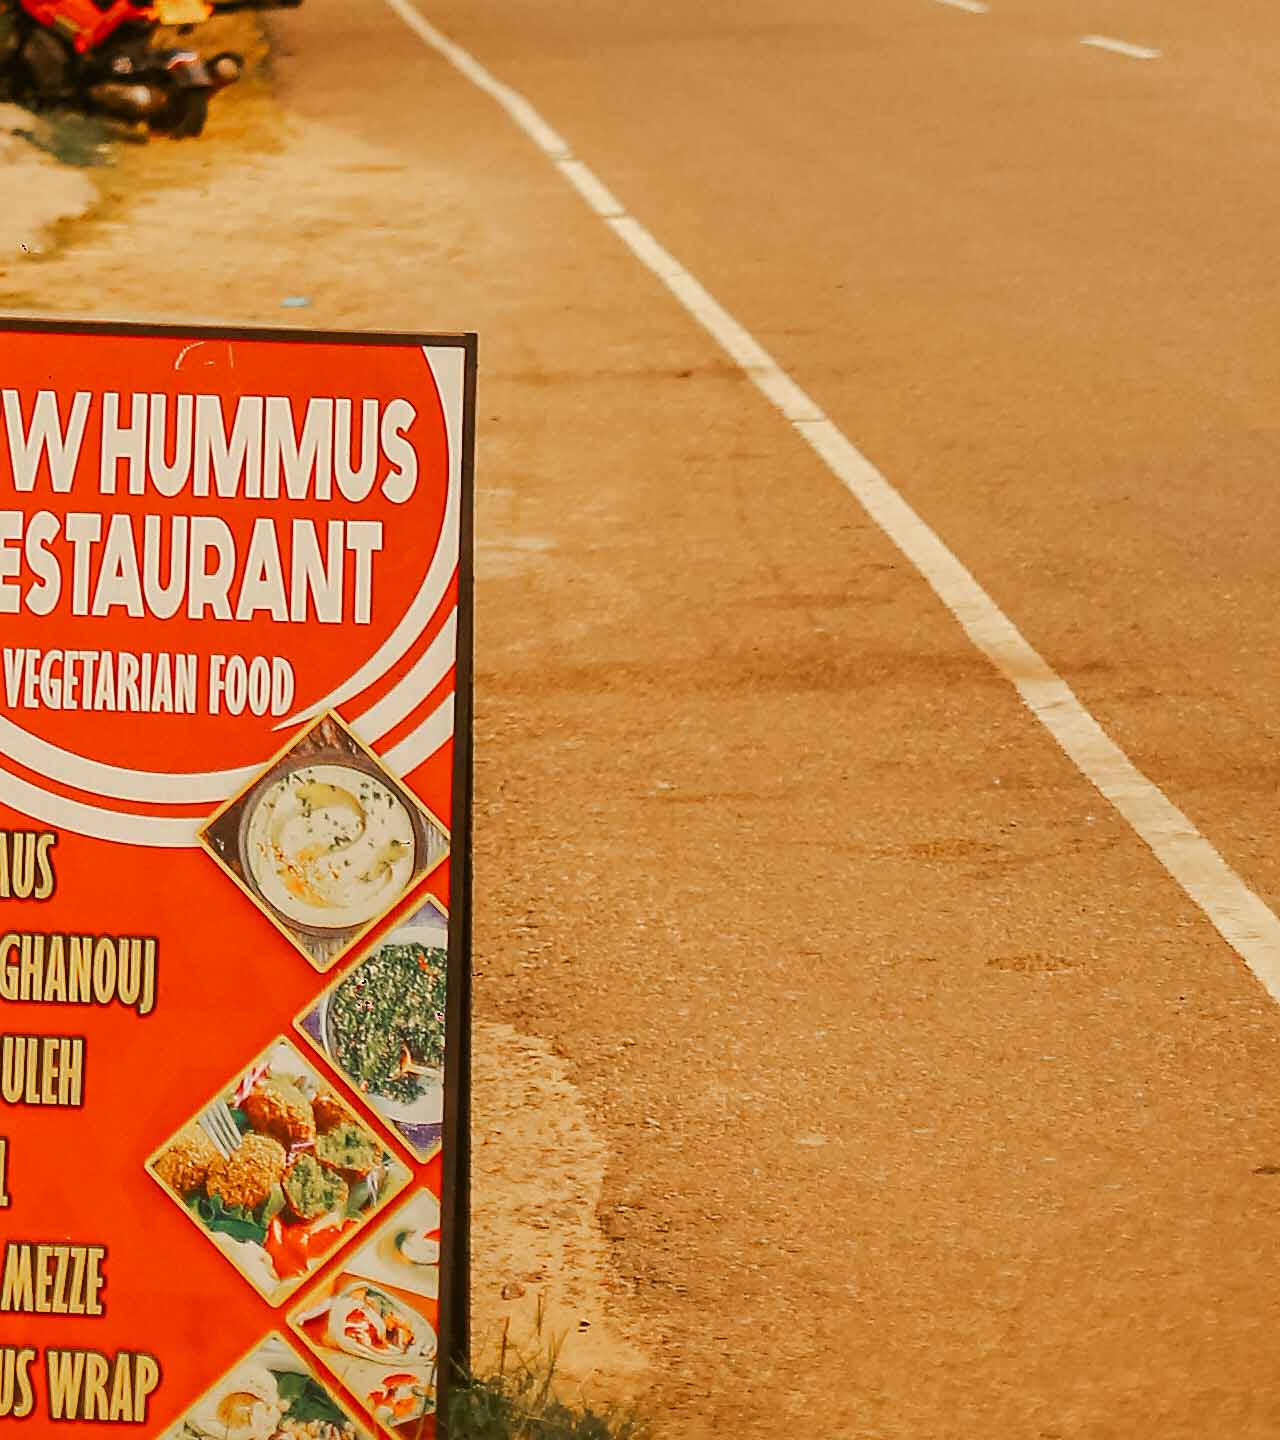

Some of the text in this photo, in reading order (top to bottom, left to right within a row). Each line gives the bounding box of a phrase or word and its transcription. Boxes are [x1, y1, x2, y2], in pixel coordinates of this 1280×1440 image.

[101, 393, 417, 503] HUMMUS
[4, 648, 293, 715] VEGETARIAN FOOD
[1, 1244, 104, 1314] MEZZE
[48, 1351, 158, 1421] WRAP
